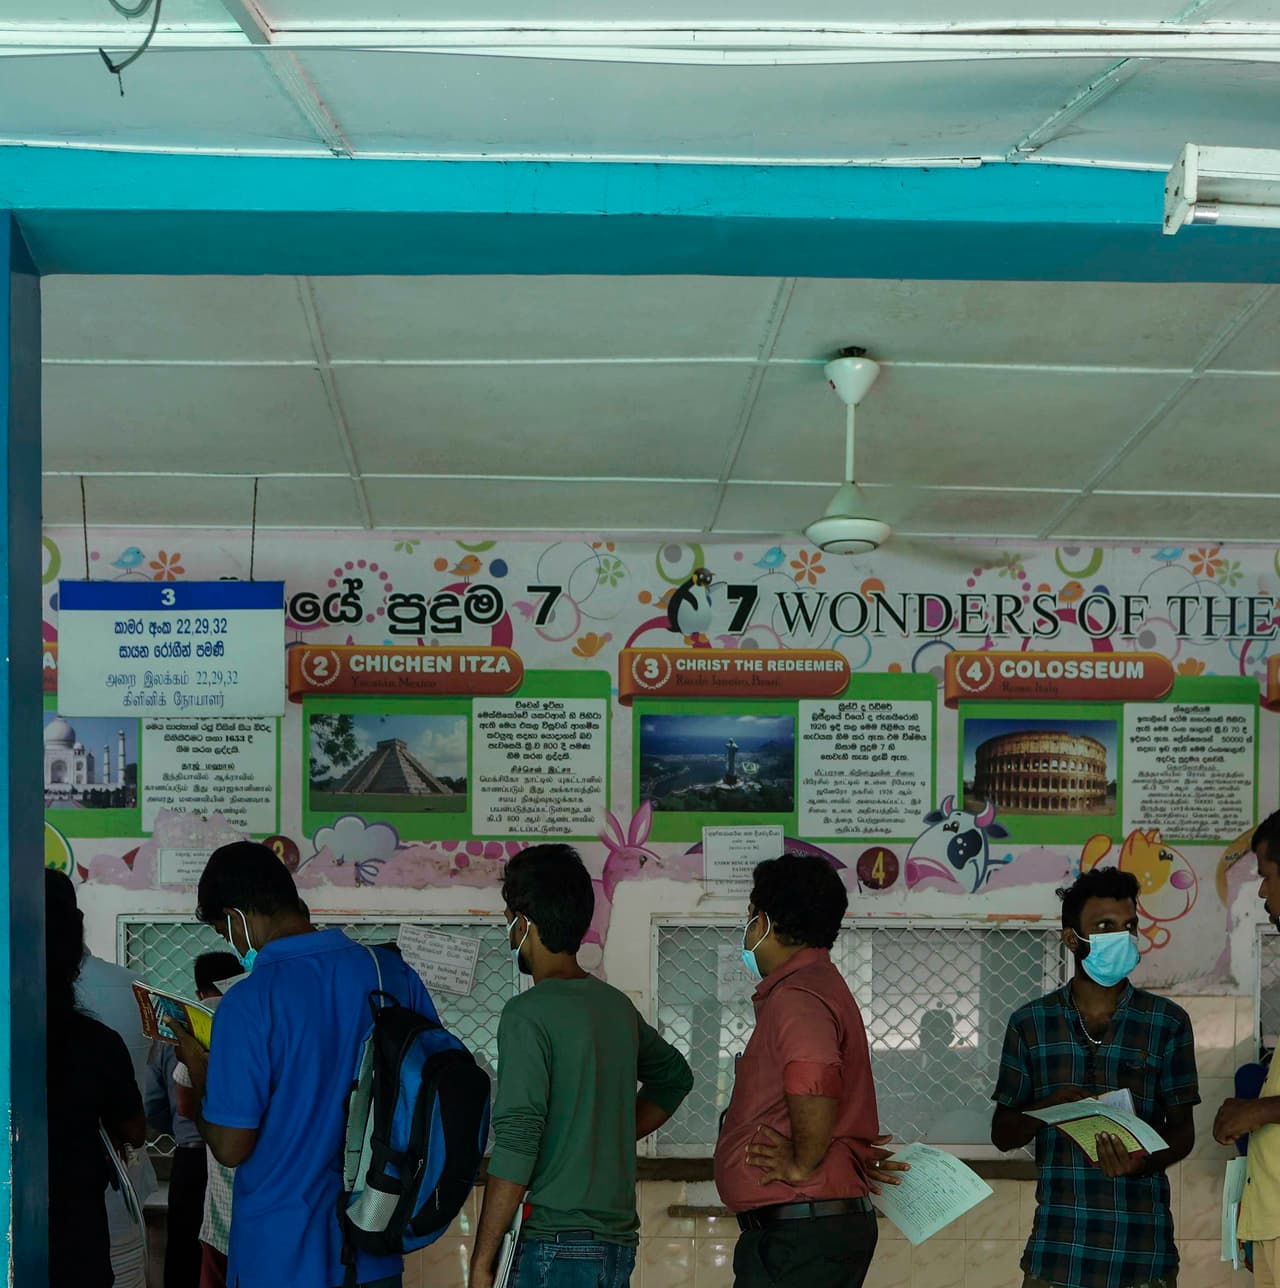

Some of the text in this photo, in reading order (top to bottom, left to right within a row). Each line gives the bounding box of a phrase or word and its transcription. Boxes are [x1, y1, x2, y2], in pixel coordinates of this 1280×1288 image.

[161, 588, 176, 606] 3
[526, 586, 562, 626] 7
[726, 584, 759, 634] 7
[774, 592, 1061, 638] WONDERS
[1077, 593, 1150, 638] OF
[1167, 594, 1279, 640] THE
[114, 619, 144, 635] කාමර
[149, 619, 172, 637] අංක
[313, 655, 512, 677] 2 CHICHEN ITZA
[644, 658, 844, 679] 3 CHRIST THE REDEEMER
[966, 660, 1145, 682] 4 COLOSSEUM
[872, 850, 885, 885] 4
